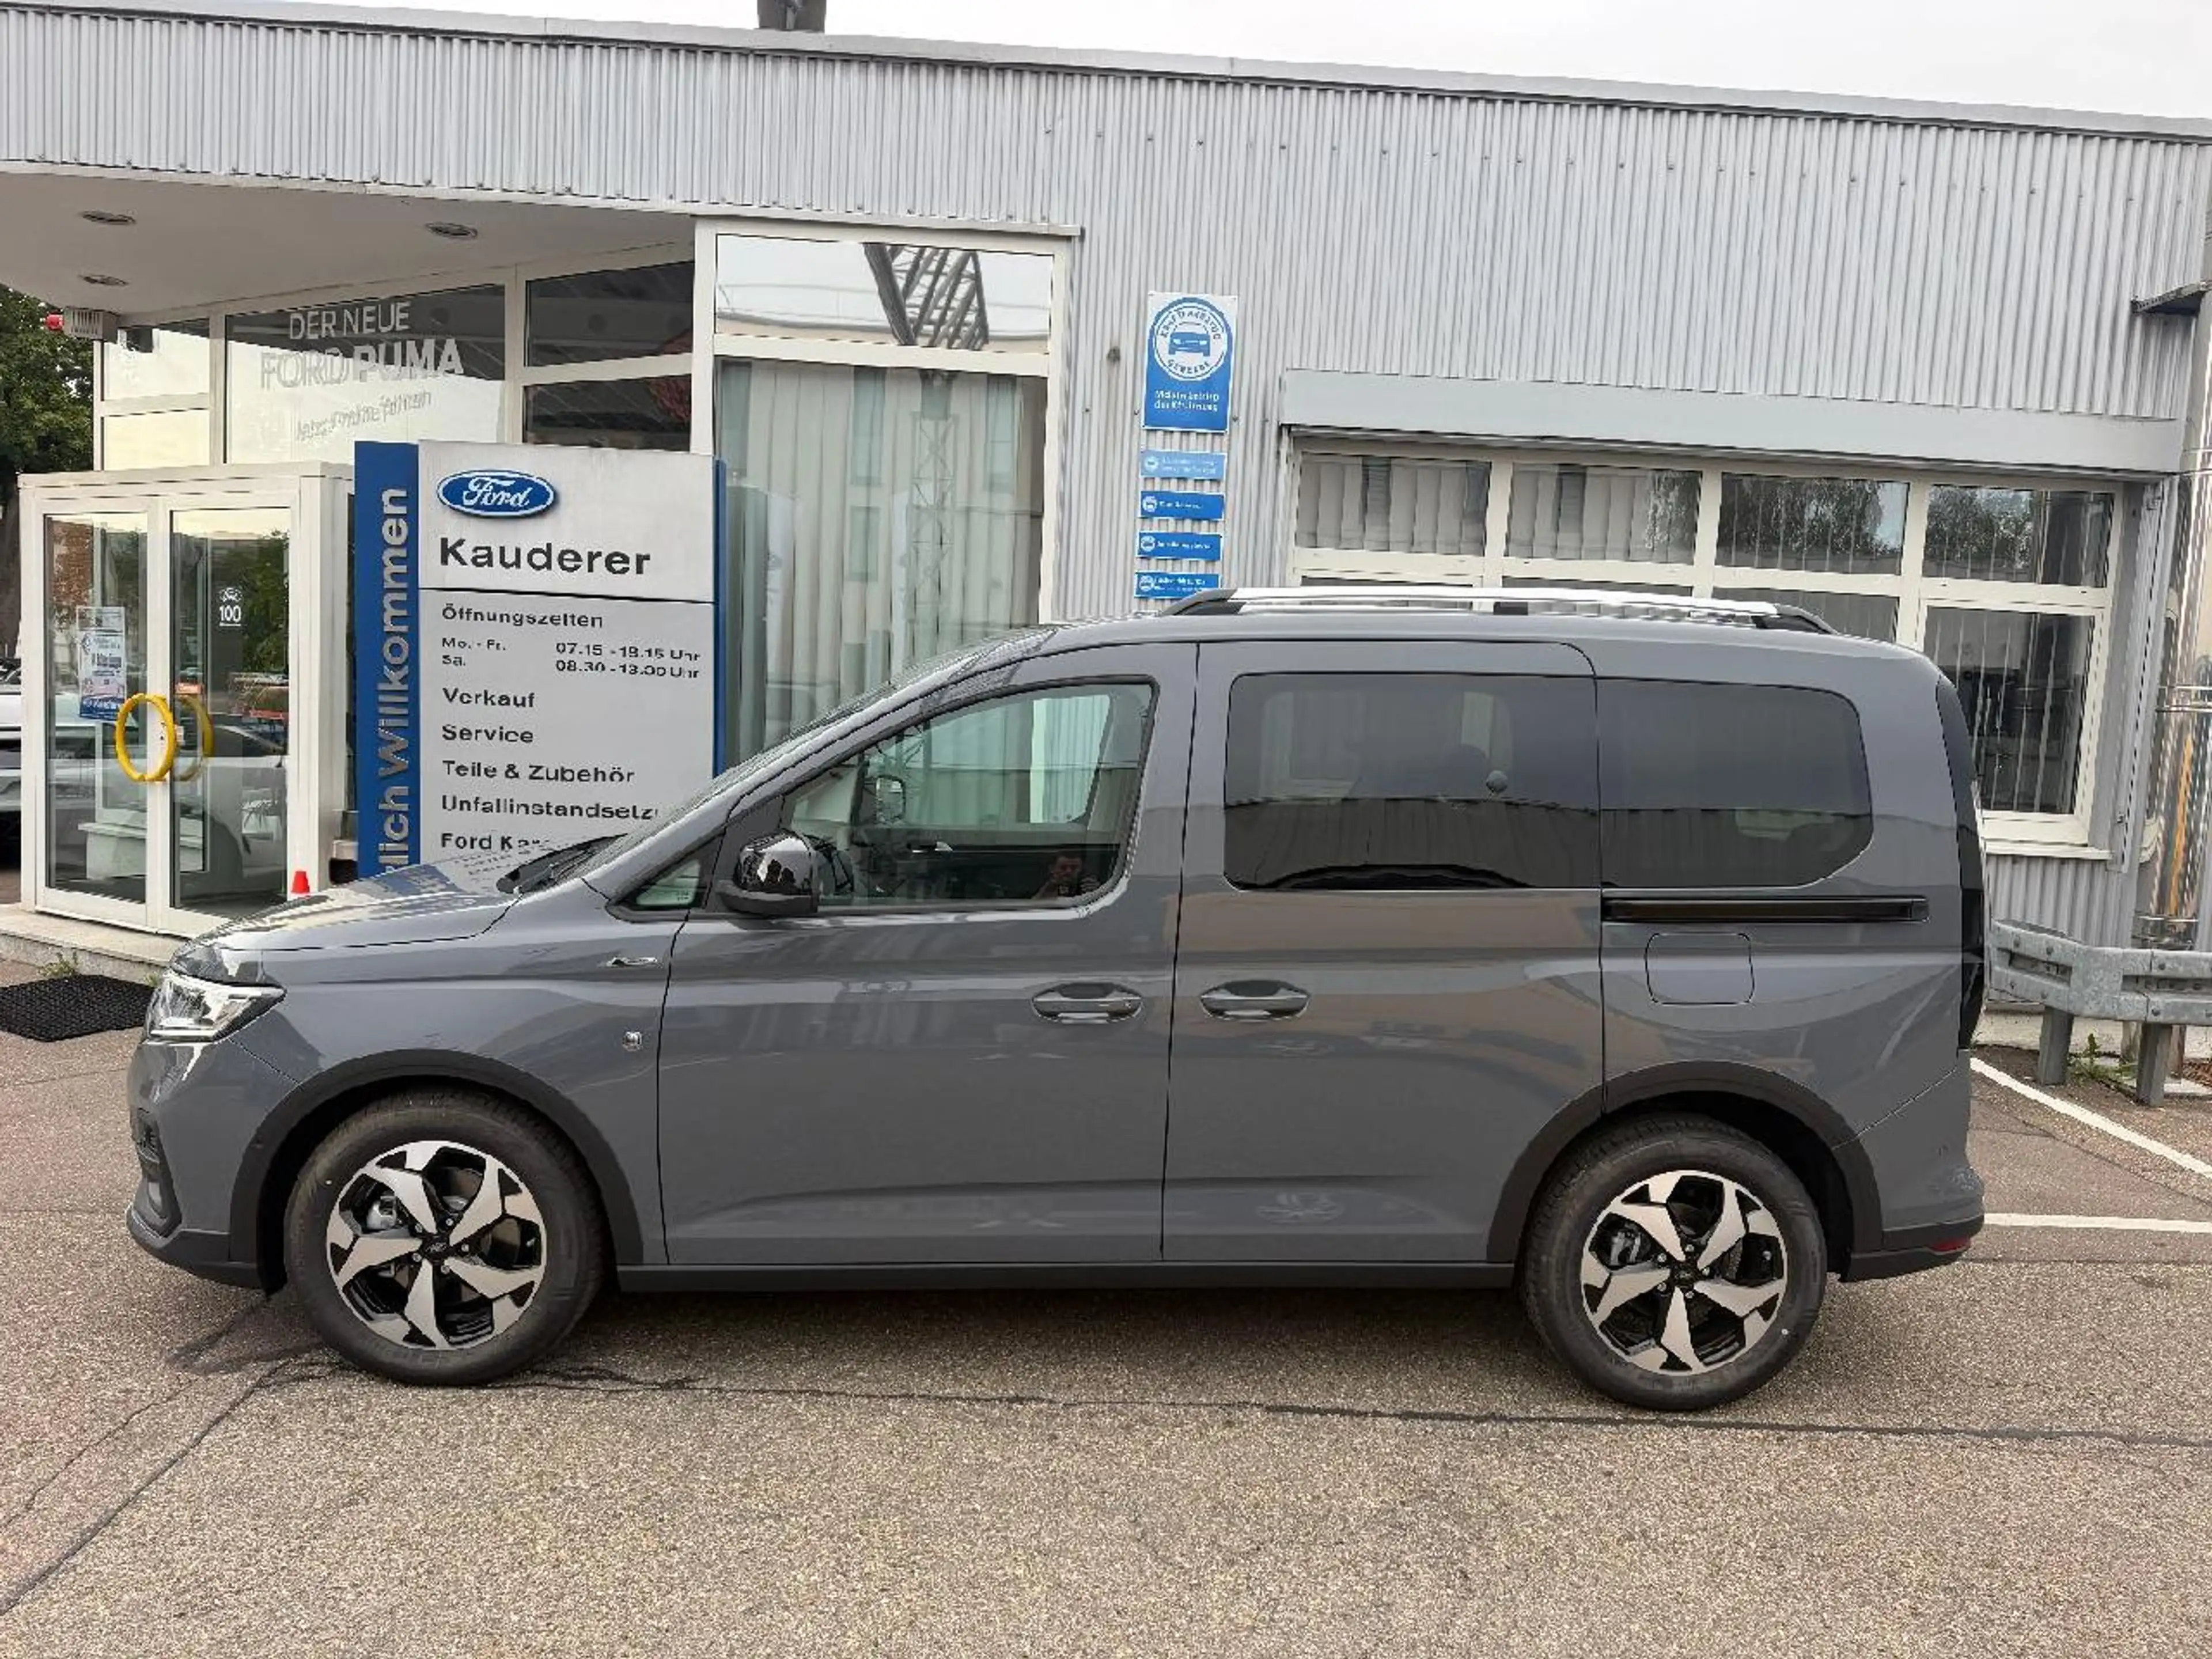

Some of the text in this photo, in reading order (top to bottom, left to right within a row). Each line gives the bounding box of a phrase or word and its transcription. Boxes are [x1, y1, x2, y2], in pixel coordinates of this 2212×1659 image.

[290, 301, 412, 340] DER NEUE
[260, 338, 464, 390] FORD PUMA
[440, 537, 651, 575] Kauderer
[442, 603, 603, 628] Öffnungszeiten
[377, 488, 410, 776] Willkommen
[442, 637, 471, 649] Mo.
[487, 639, 506, 651] Fr.
[556, 642, 603, 656] 07.15
[442, 654, 466, 666] Sa.
[442, 687, 535, 708] Verkauf
[442, 724, 533, 744] Service
[442, 760, 635, 783] Teile & Zubehör
[441, 832, 492, 850] Ford
